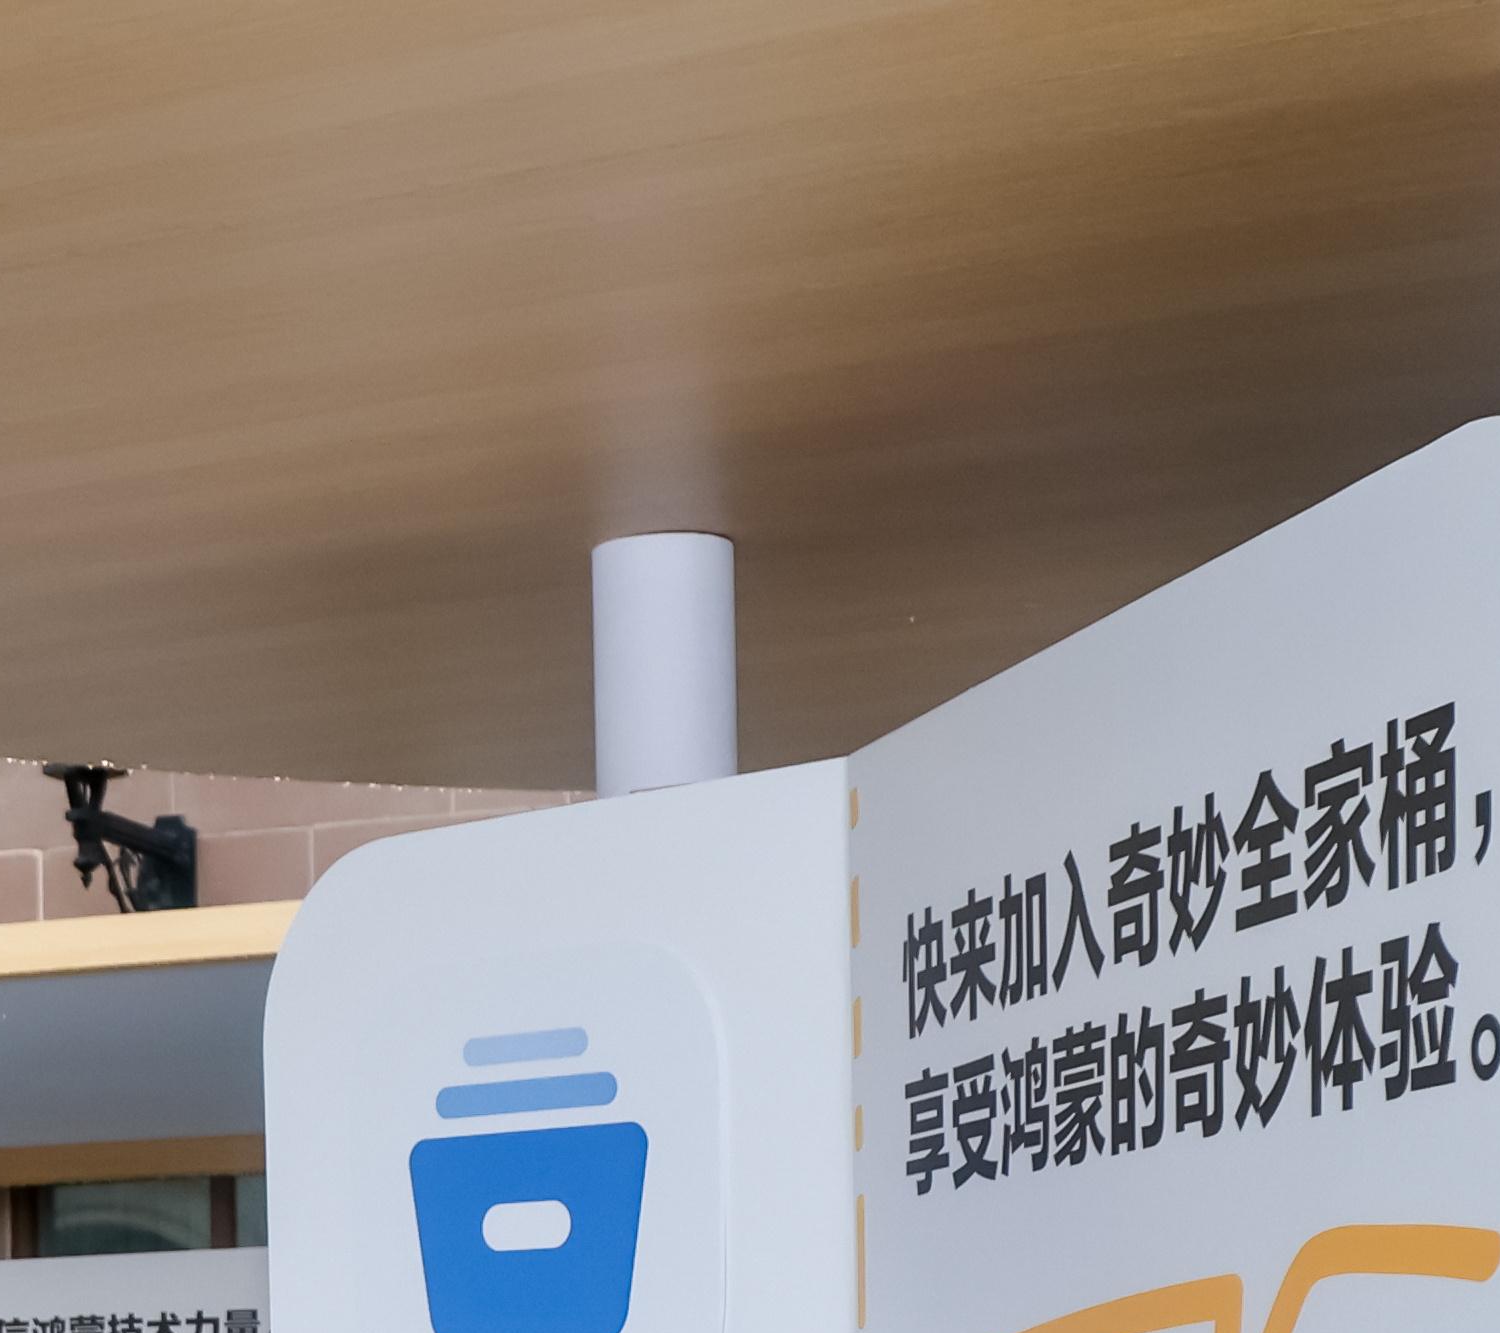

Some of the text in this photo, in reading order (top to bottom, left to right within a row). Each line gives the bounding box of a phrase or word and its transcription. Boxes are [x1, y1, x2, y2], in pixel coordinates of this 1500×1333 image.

[902, 701, 1492, 1039] 快来加入奇妙全家桶，
